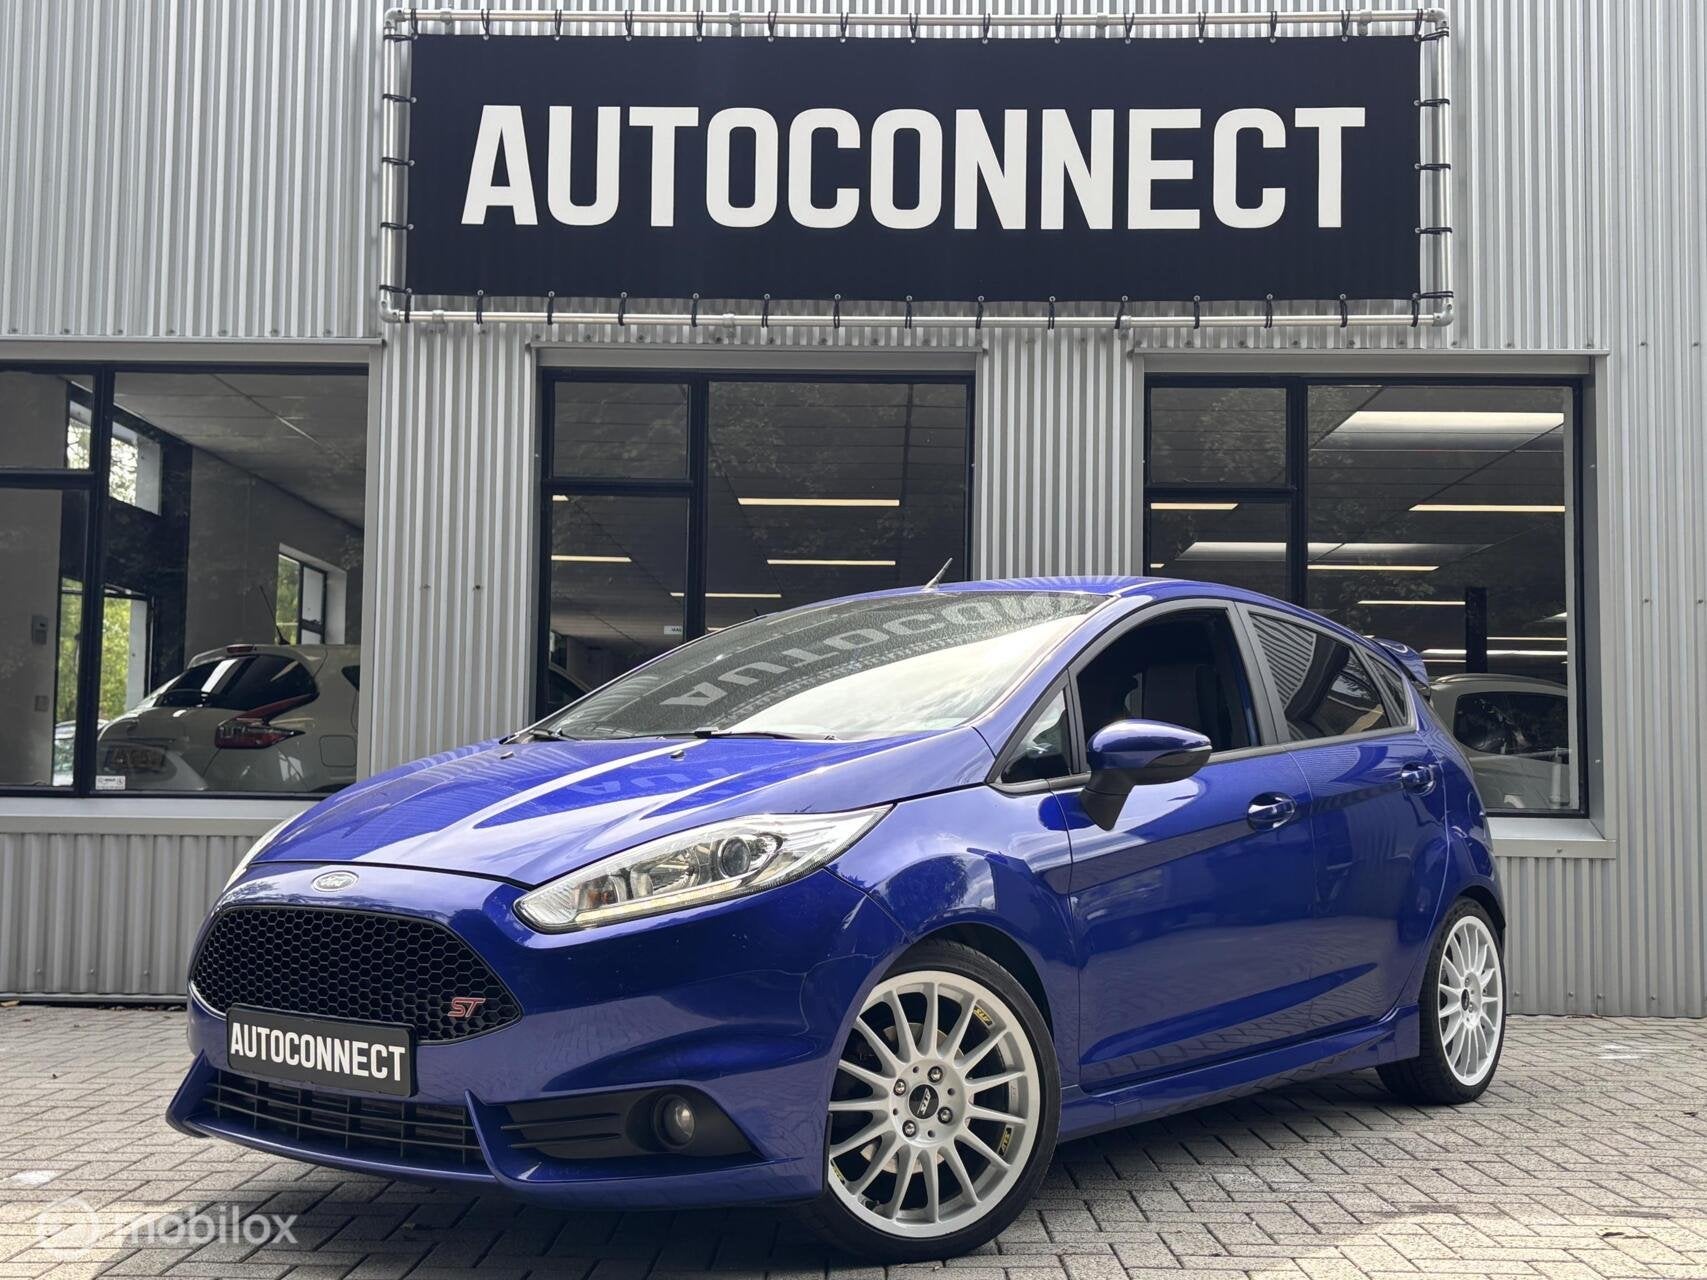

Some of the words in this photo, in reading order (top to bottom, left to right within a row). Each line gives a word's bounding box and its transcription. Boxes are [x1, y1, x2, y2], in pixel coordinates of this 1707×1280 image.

[461, 105, 1366, 230] AUTOCONNECT
[447, 998, 486, 1018] ST
[230, 1022, 405, 1081] AUTOCONNECT
